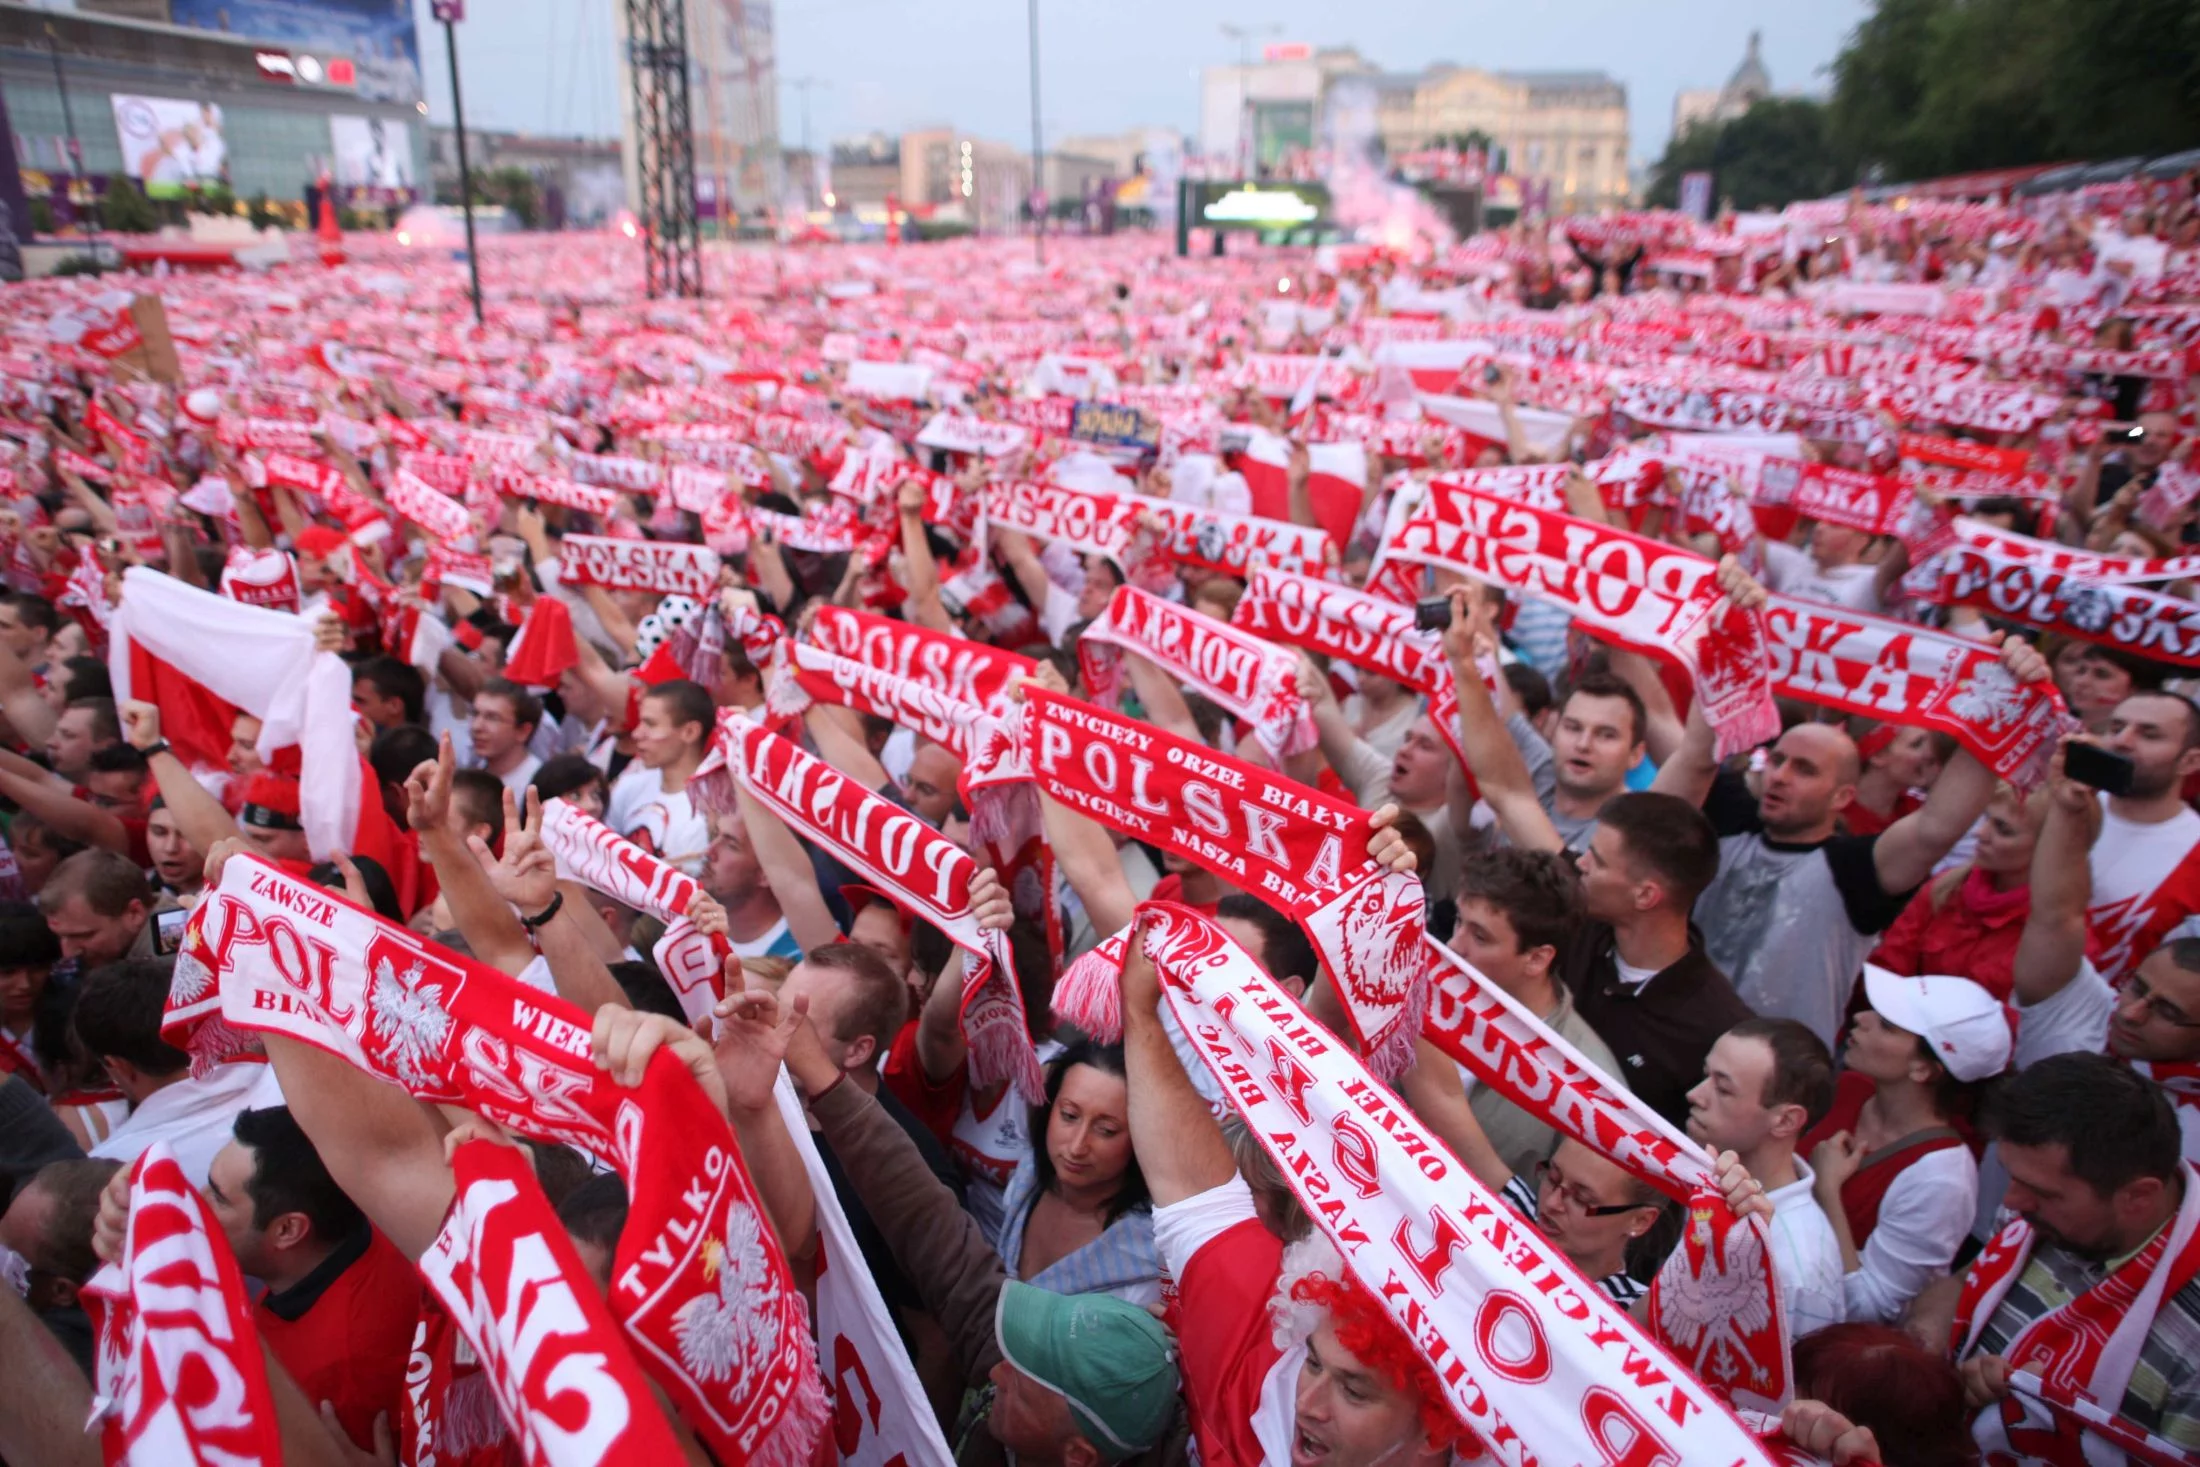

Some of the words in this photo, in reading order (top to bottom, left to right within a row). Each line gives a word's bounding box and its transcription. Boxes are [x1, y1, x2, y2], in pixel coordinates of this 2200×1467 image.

[562, 541, 709, 597] POLSKA
[1038, 718, 1343, 889] POLSKA
[1045, 701, 1154, 752] ZWYCIĘŻY
[1166, 746, 1247, 792] ORZEŁ
[1260, 783, 1354, 832] BIAŁY
[1171, 825, 1247, 876] NASZA
[250, 870, 338, 929] ZAWSZE
[618, 1144, 724, 1300] TYLKO
